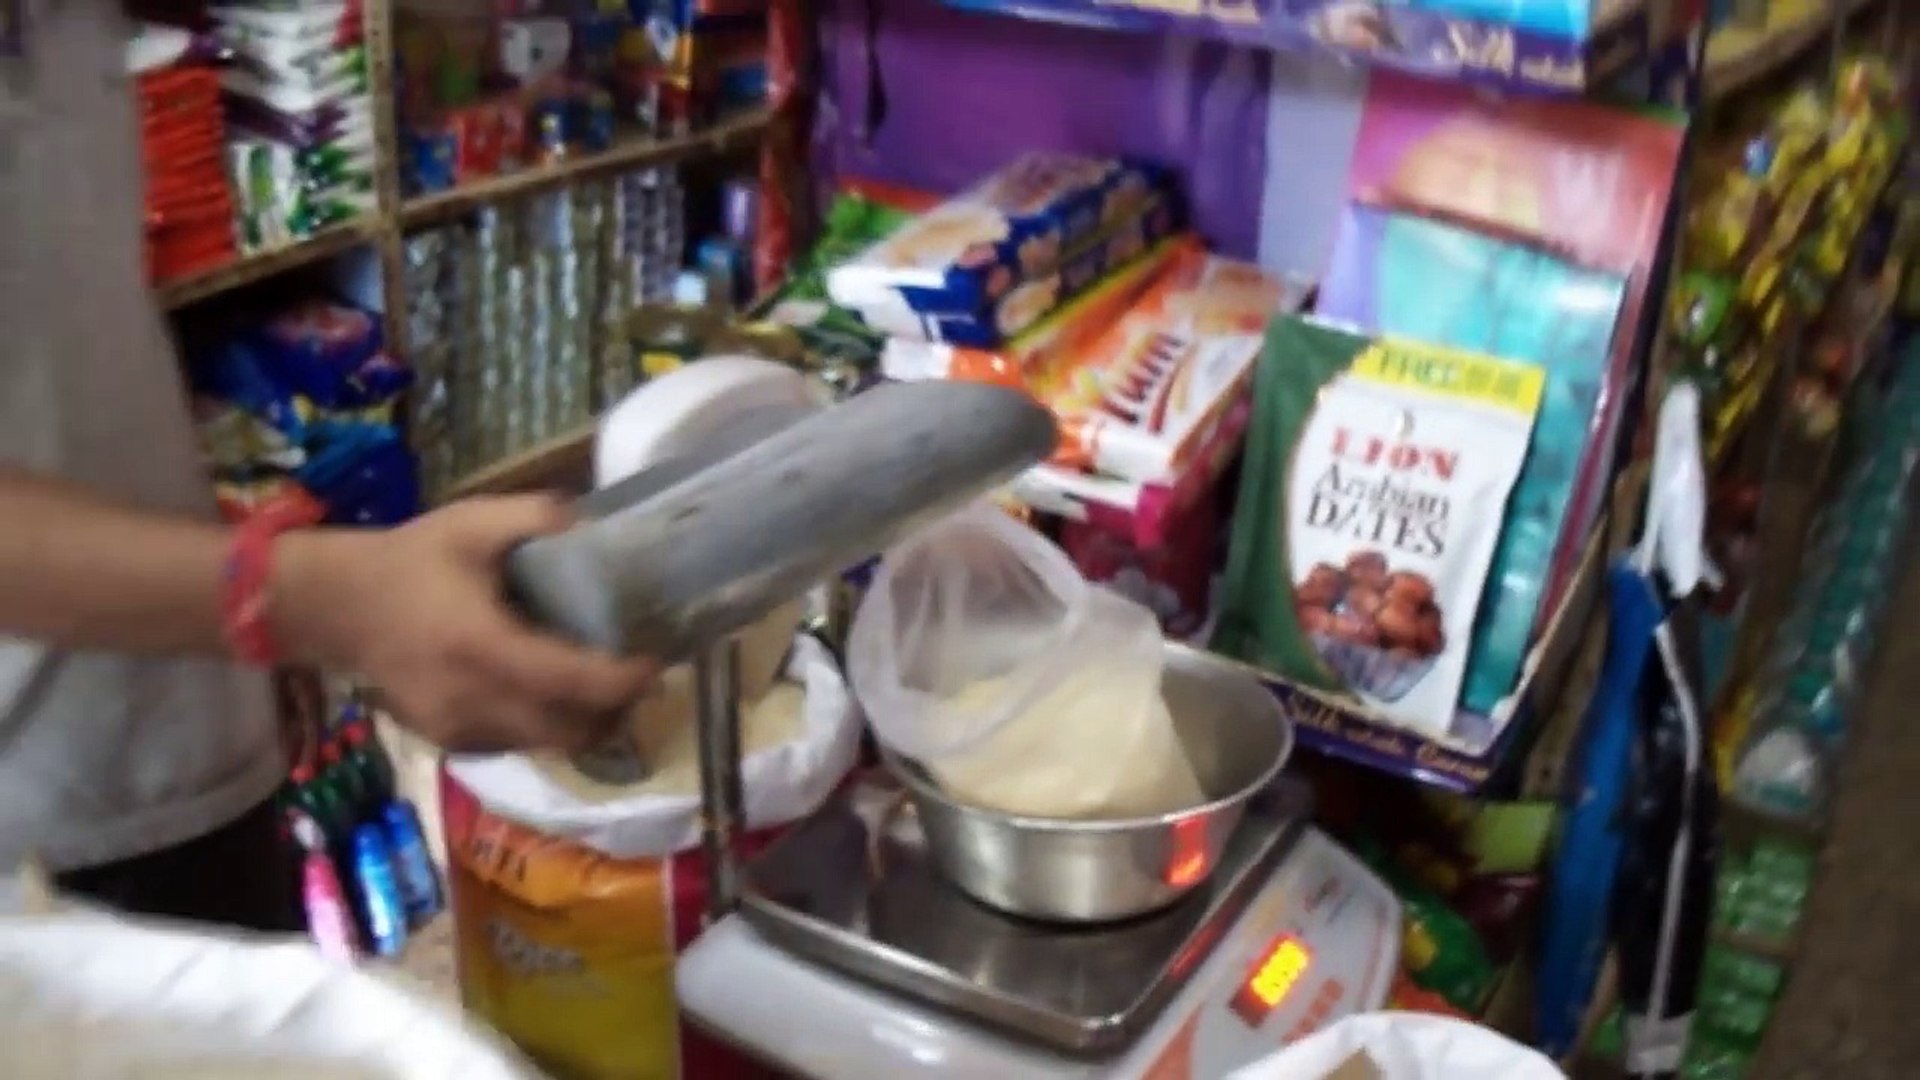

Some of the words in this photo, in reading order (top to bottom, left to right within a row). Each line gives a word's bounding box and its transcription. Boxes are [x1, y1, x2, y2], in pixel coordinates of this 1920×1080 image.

[1331, 427, 1459, 480] LION
[1312, 463, 1451, 521] Arabian
[1306, 494, 1445, 558] DATES
